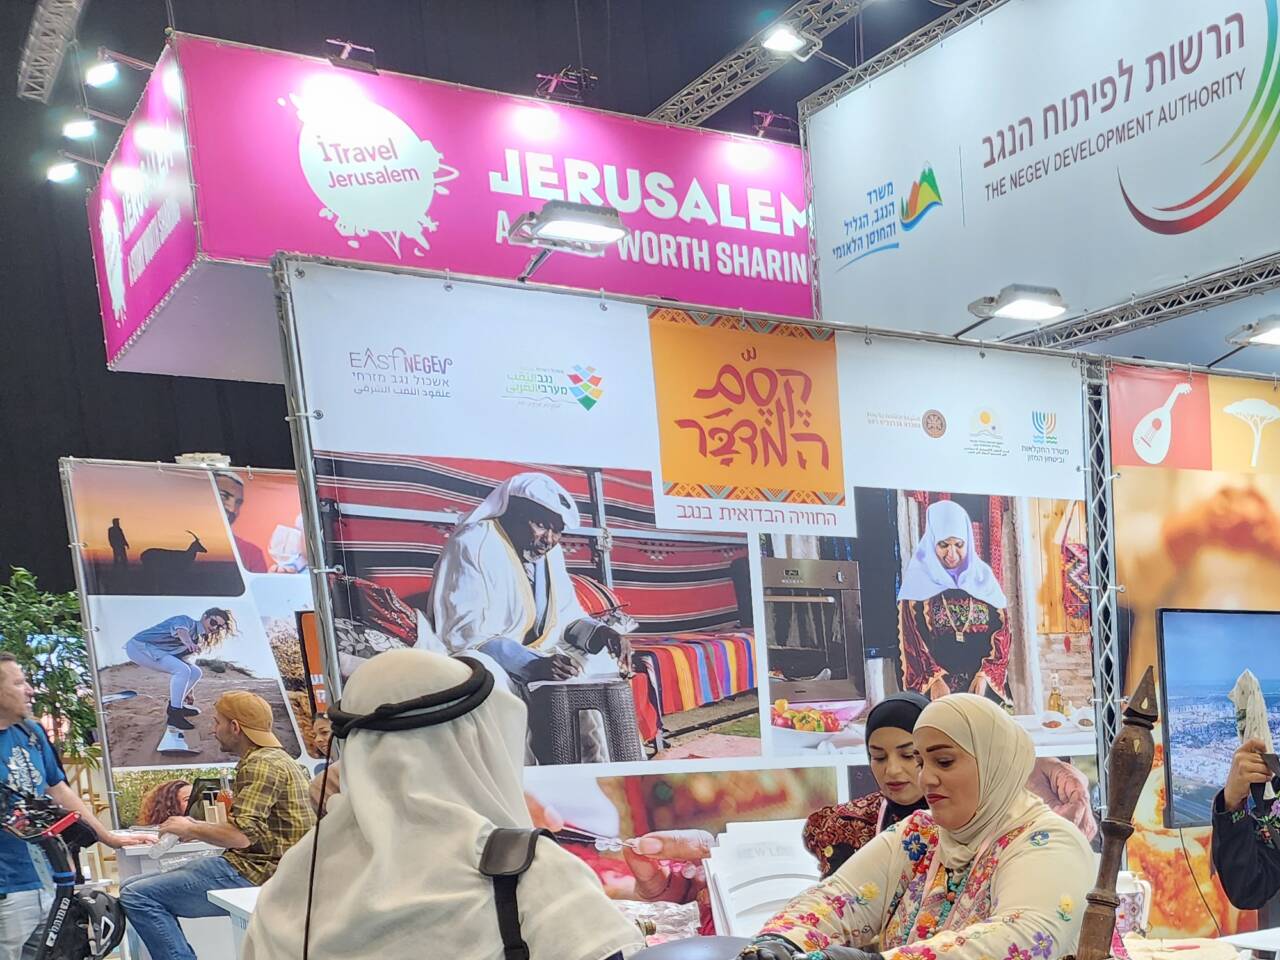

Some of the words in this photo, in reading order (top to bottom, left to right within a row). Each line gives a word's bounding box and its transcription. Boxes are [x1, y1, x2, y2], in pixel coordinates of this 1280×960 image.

[1145, 12, 1245, 93] הרשות
[1042, 58, 1134, 140] לפיתוח
[982, 116, 1034, 169] הנגב
[984, 176, 1007, 202] THE
[1009, 156, 1050, 191] NEGEV
[1053, 110, 1154, 172] DEVELOPMENT
[1158, 67, 1246, 127] AUTHORITY
[328, 165, 420, 189] Jerusalem
[489, 148, 811, 237] JERUSALEM
[866, 181, 894, 204] משרד
[844, 213, 869, 235] הגליל
[866, 221, 896, 249] והחוסן
[617, 230, 711, 272] WORTH
[716, 241, 809, 285] SHARIN
[832, 236, 864, 260] הלאומי
[404, 354, 454, 375] NEGEV
[352, 371, 386, 383] מזרחי
[392, 375, 409, 385] נגב
[413, 374, 450, 387] אשכול
[677, 504, 712, 520] בנגב
[719, 506, 785, 524] הבדואית
[789, 510, 837, 526] החוויה
